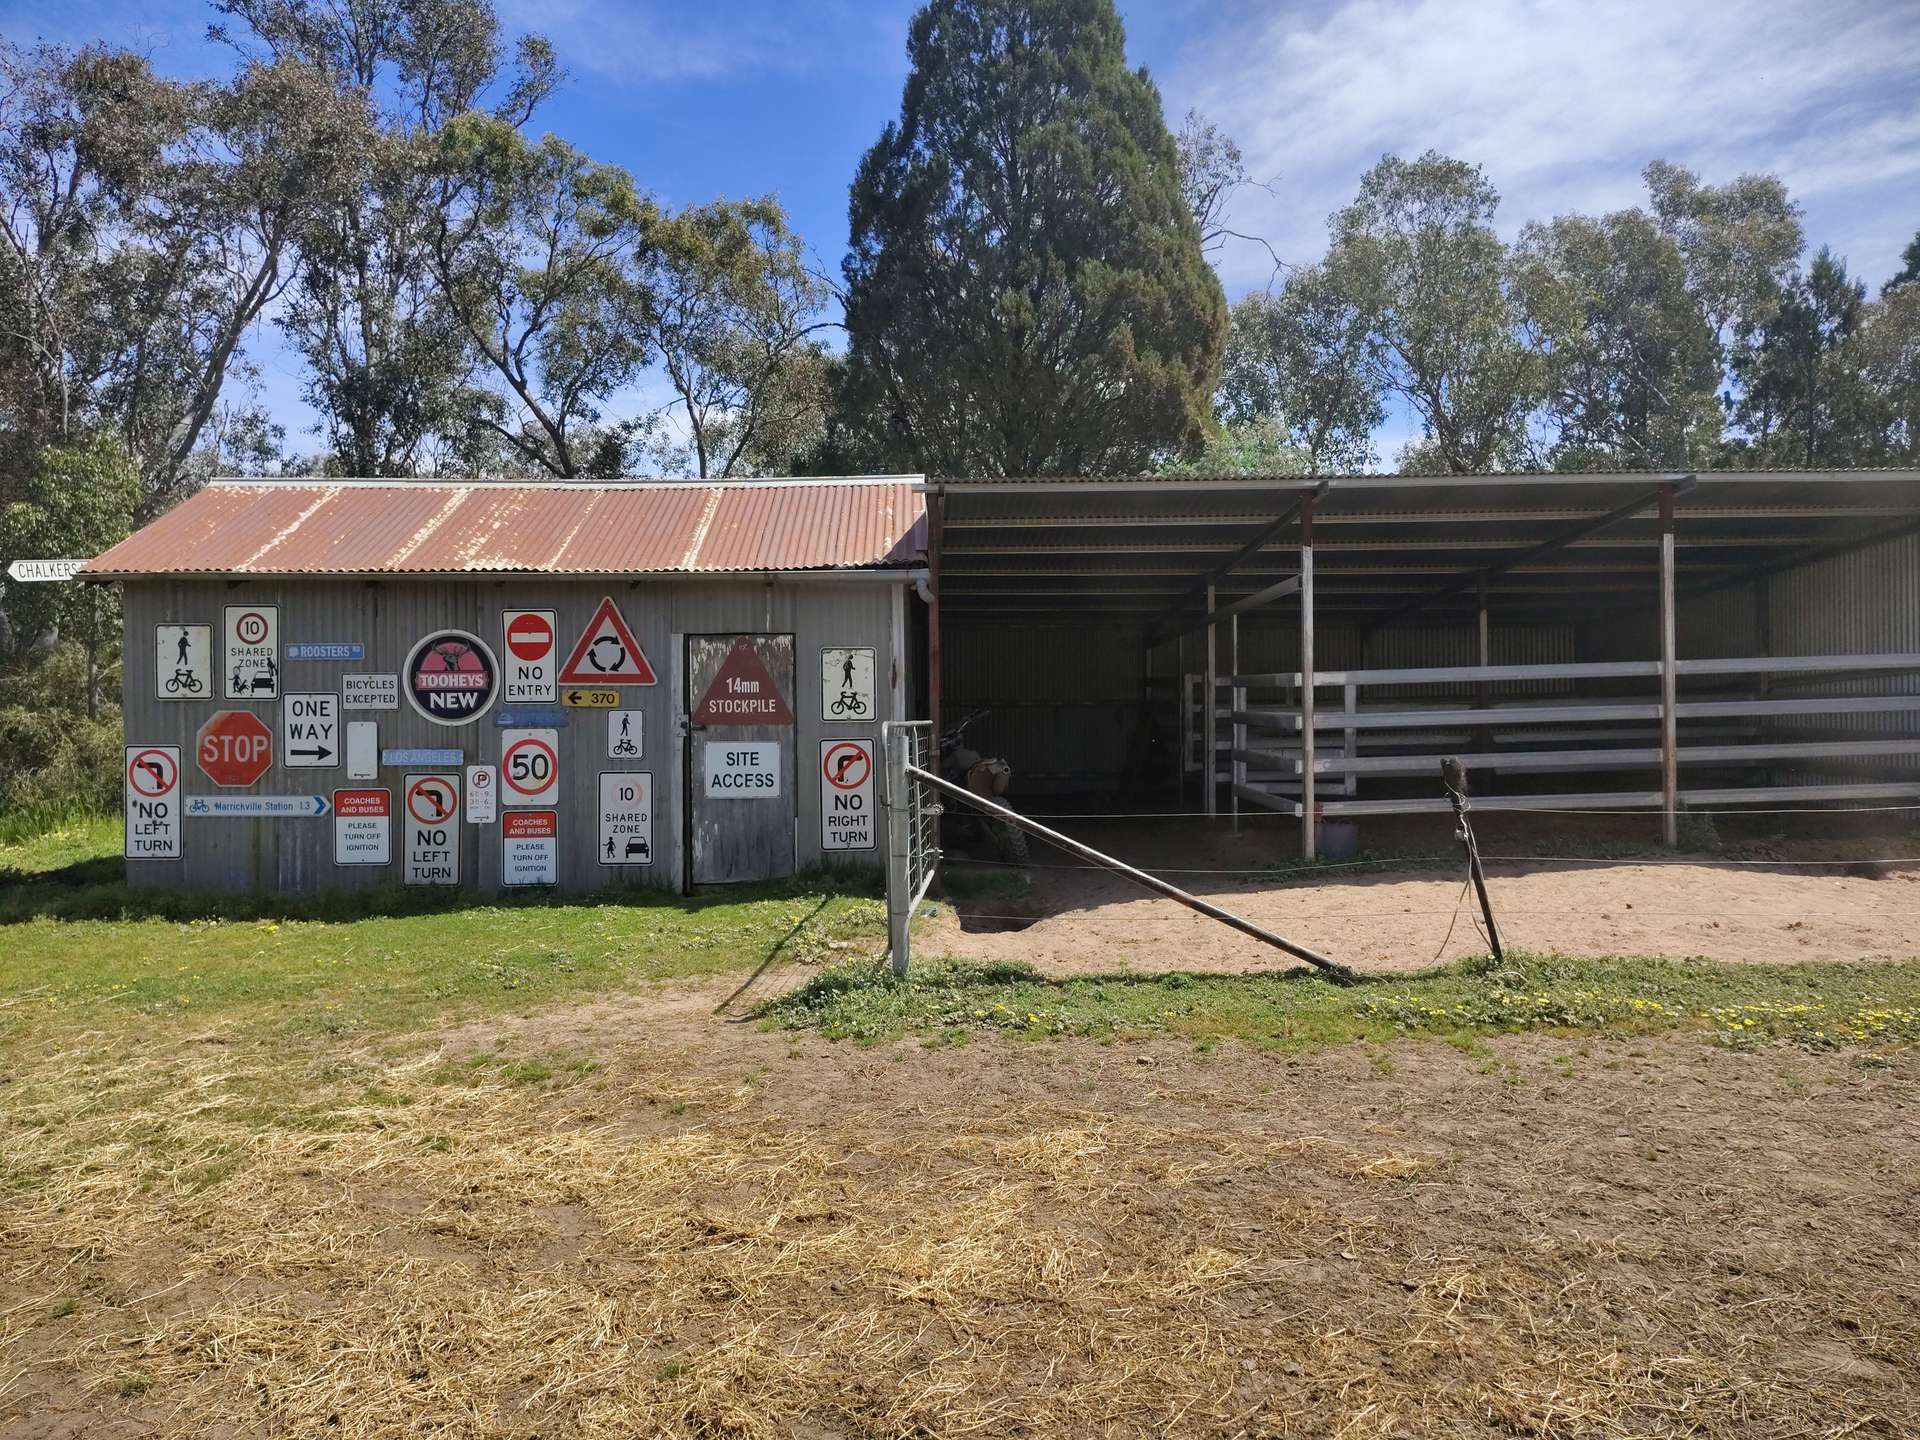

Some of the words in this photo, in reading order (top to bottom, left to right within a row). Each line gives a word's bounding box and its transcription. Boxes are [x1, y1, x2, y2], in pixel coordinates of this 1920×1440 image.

[18, 563, 78, 577] CHALKERS
[245, 622, 260, 635] 10
[231, 648, 273, 656] SHARED
[301, 646, 350, 656] ROOSTERS
[239, 659, 266, 668] ZONE
[419, 673, 484, 686] TOOHEYS
[519, 667, 543, 680] NO
[346, 680, 395, 689] BICYCLES
[509, 685, 552, 695] ENTRY
[726, 677, 759, 693] 14mm
[346, 694, 395, 704] EXCEPTED
[430, 692, 478, 709] NEW
[591, 693, 615, 704] 370
[292, 701, 330, 717] ONE
[709, 699, 776, 713] STOCKPILE
[290, 724, 333, 740] WAY
[203, 736, 269, 762] STOP
[726, 752, 759, 766] SITE
[512, 755, 549, 780] 50
[712, 774, 774, 788] ACCESS
[619, 788, 633, 800] 10
[214, 802, 261, 811] Marrickville
[264, 802, 293, 811] Station
[835, 794, 862, 810] NO
[139, 803, 168, 818] NO
[605, 814, 648, 822] SHARED
[828, 815, 868, 826] RIGHT
[135, 823, 170, 835] LEFT
[613, 825, 640, 833] ZONE
[417, 830, 446, 846] NO
[831, 831, 867, 843] TURN
[135, 840, 172, 851] TURN
[413, 851, 450, 862] LEFT
[413, 867, 451, 878] TURN
